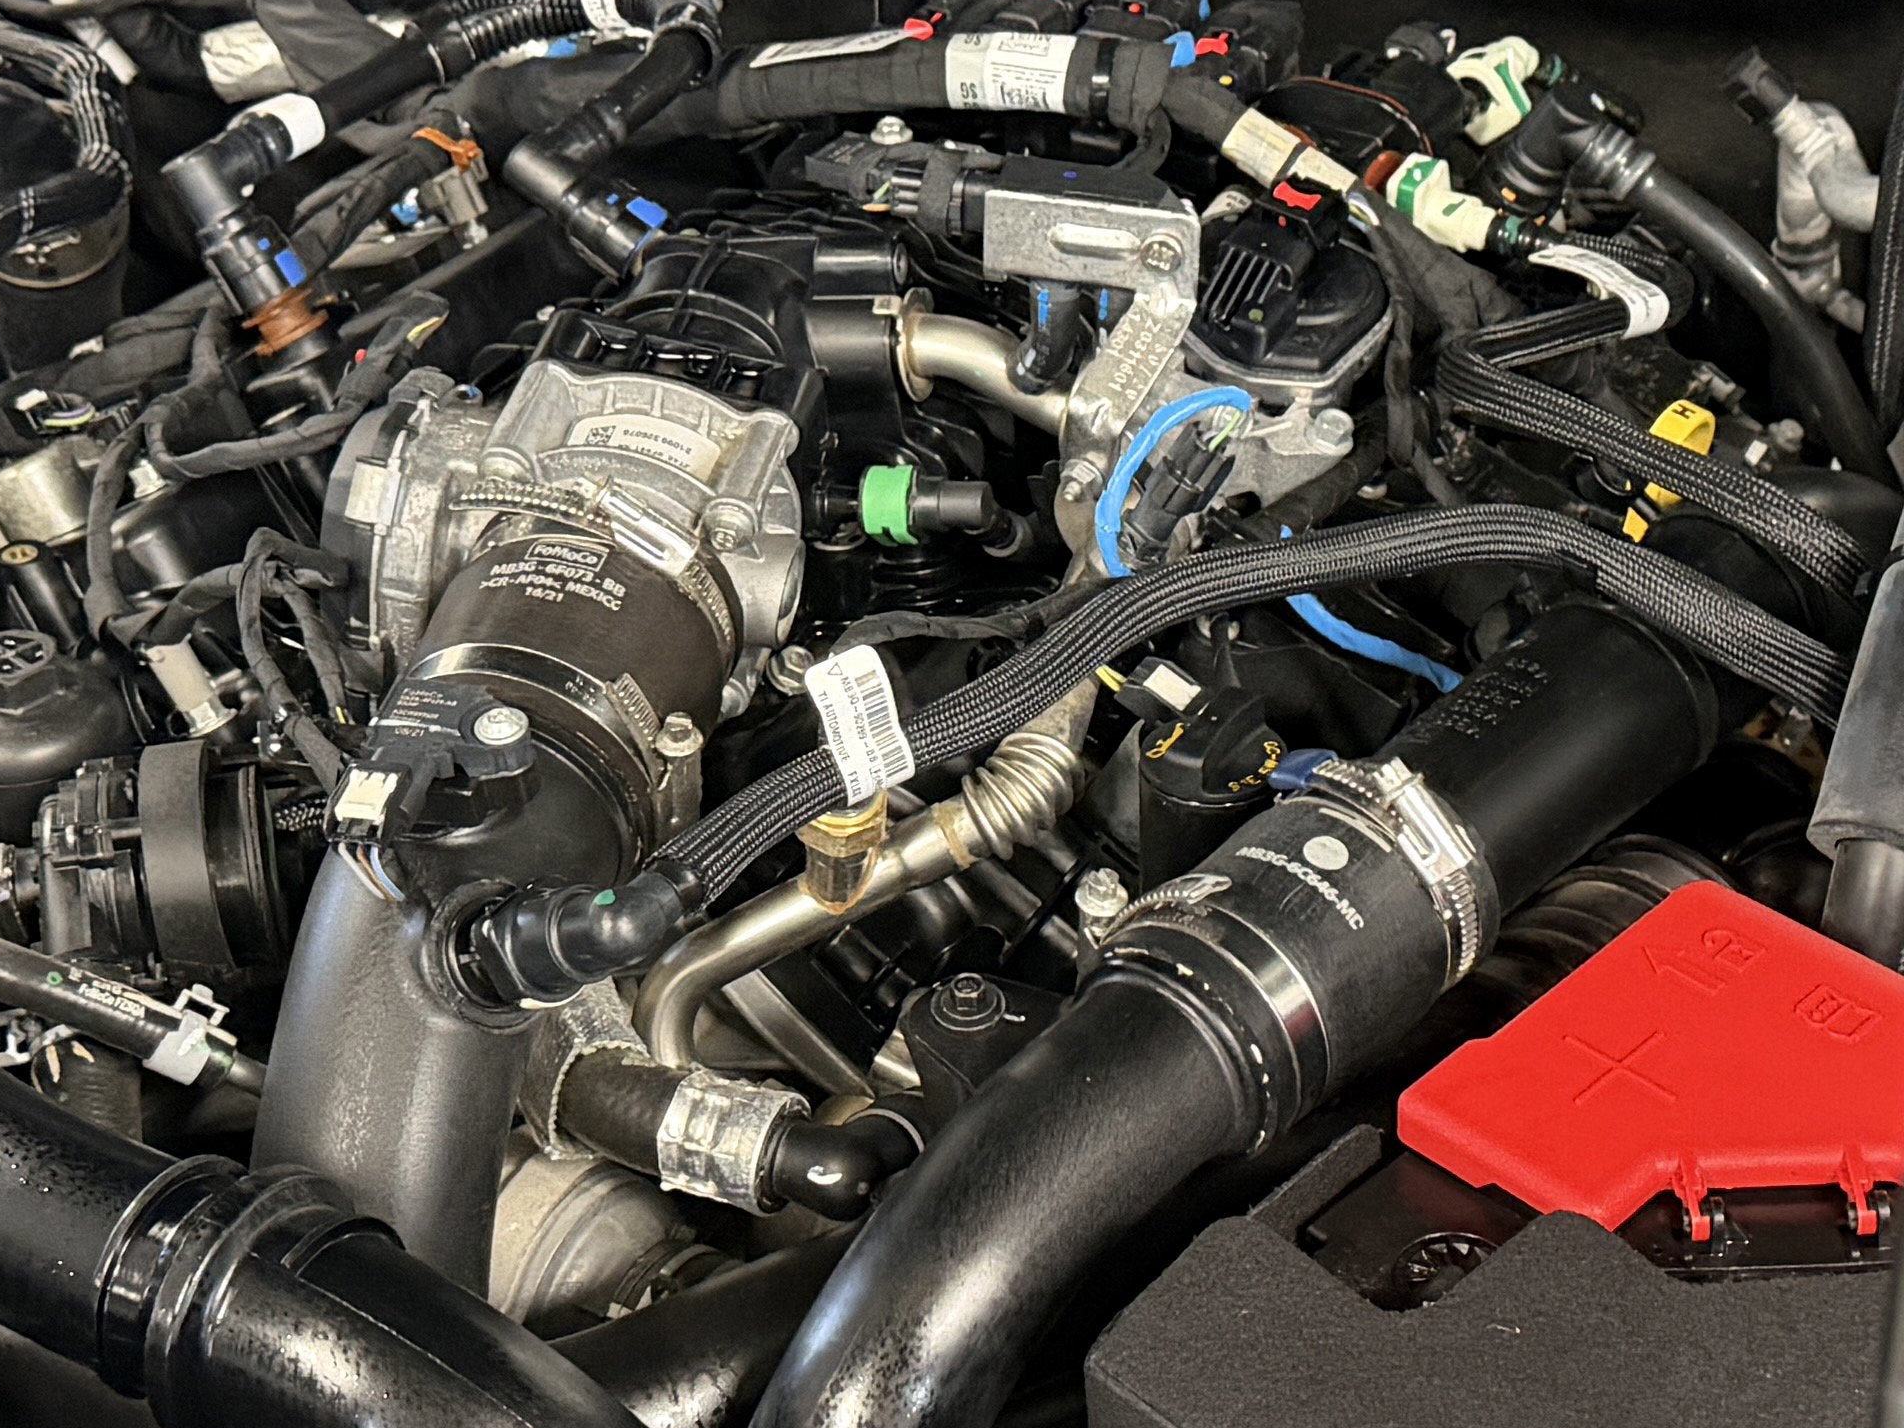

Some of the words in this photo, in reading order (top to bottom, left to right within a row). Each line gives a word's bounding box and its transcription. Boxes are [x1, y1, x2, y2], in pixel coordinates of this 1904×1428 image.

[959, 82, 977, 98] SG
[1671, 403, 1697, 420] H
[533, 541, 598, 566] FoMoCo
[822, 704, 851, 762] AUTOMOTIVE
[1235, 845, 1366, 930] MB3G-6C646-MC
